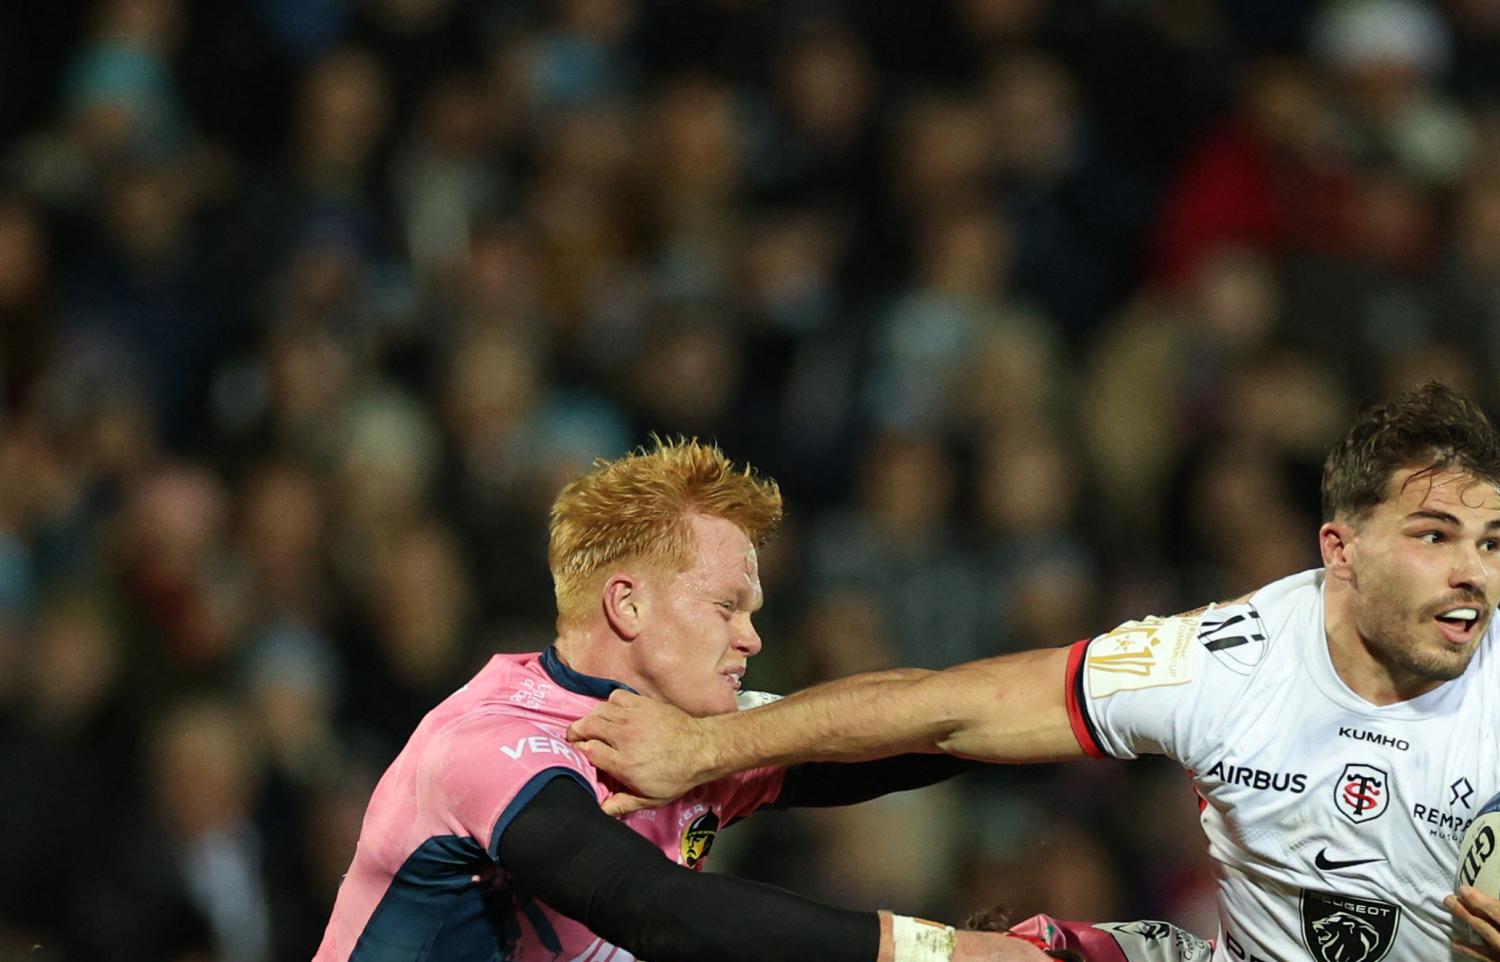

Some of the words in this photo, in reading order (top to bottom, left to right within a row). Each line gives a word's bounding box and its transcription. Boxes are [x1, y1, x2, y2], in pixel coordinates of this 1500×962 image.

[1338, 727, 1410, 752] KUMHO
[1206, 761, 1307, 794] AIRBUS
[1412, 803, 1473, 832] REMPA
[1459, 826, 1495, 888] GIL
[1308, 892, 1390, 918] PEUGEOT
